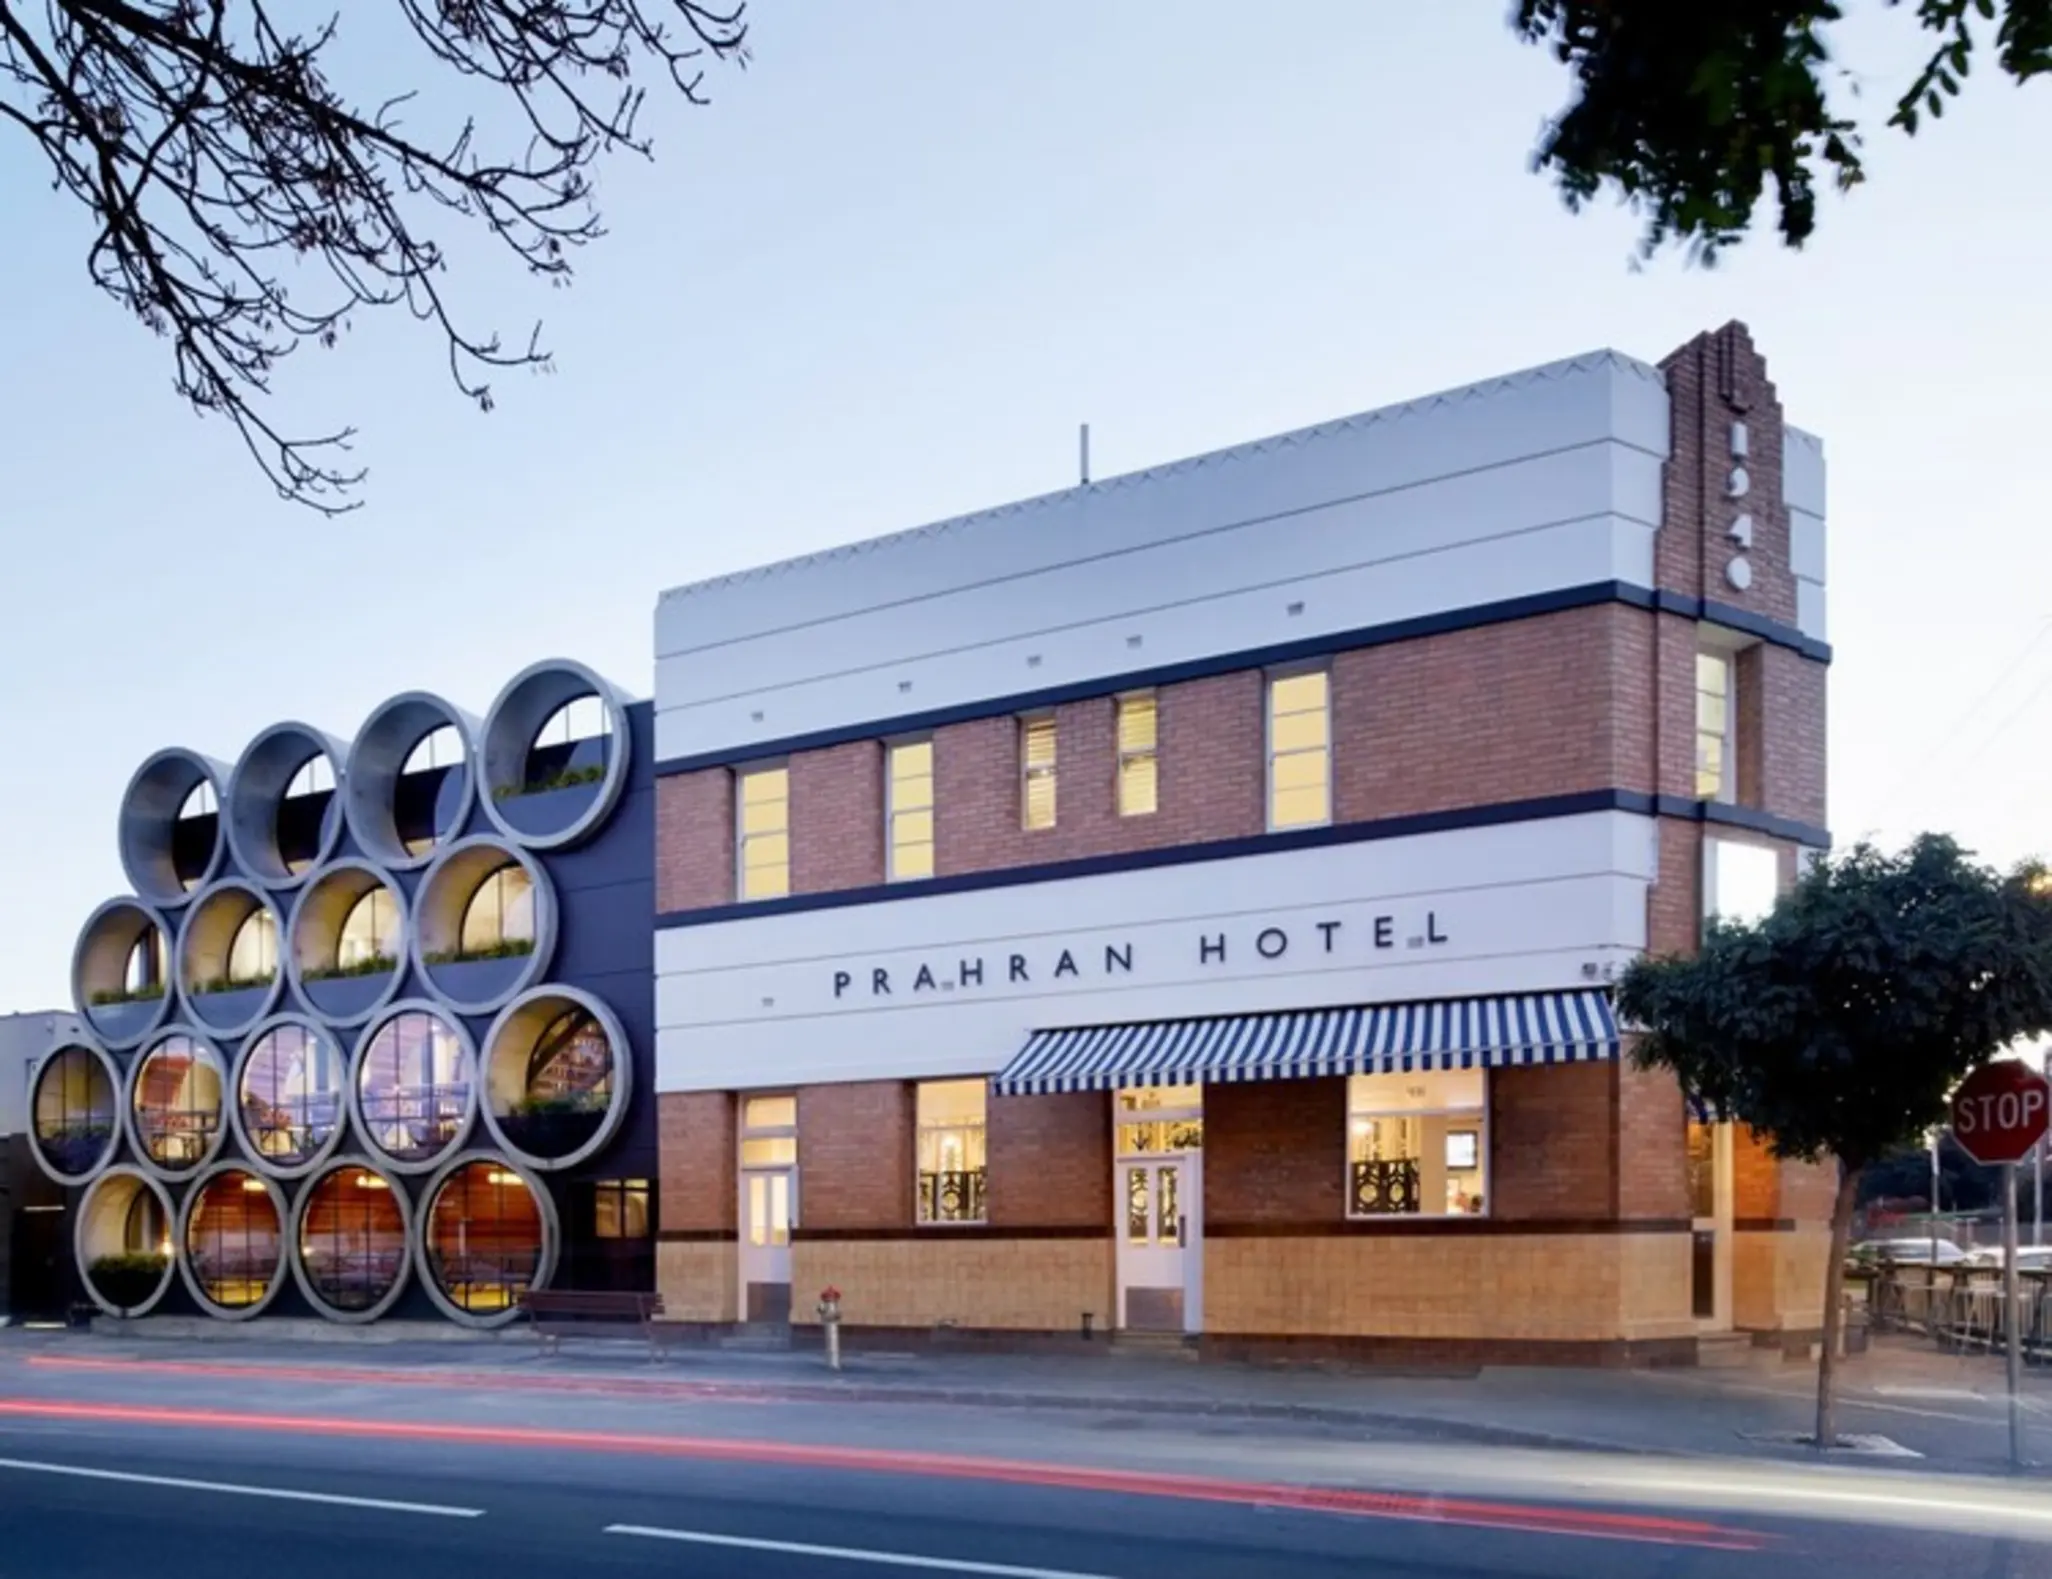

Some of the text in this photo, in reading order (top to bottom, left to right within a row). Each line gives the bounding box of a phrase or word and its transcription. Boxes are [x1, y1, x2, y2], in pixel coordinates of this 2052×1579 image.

[833, 912, 1448, 998] PRAHRAN HOTEL
[1957, 1090, 2044, 1133] STOP
